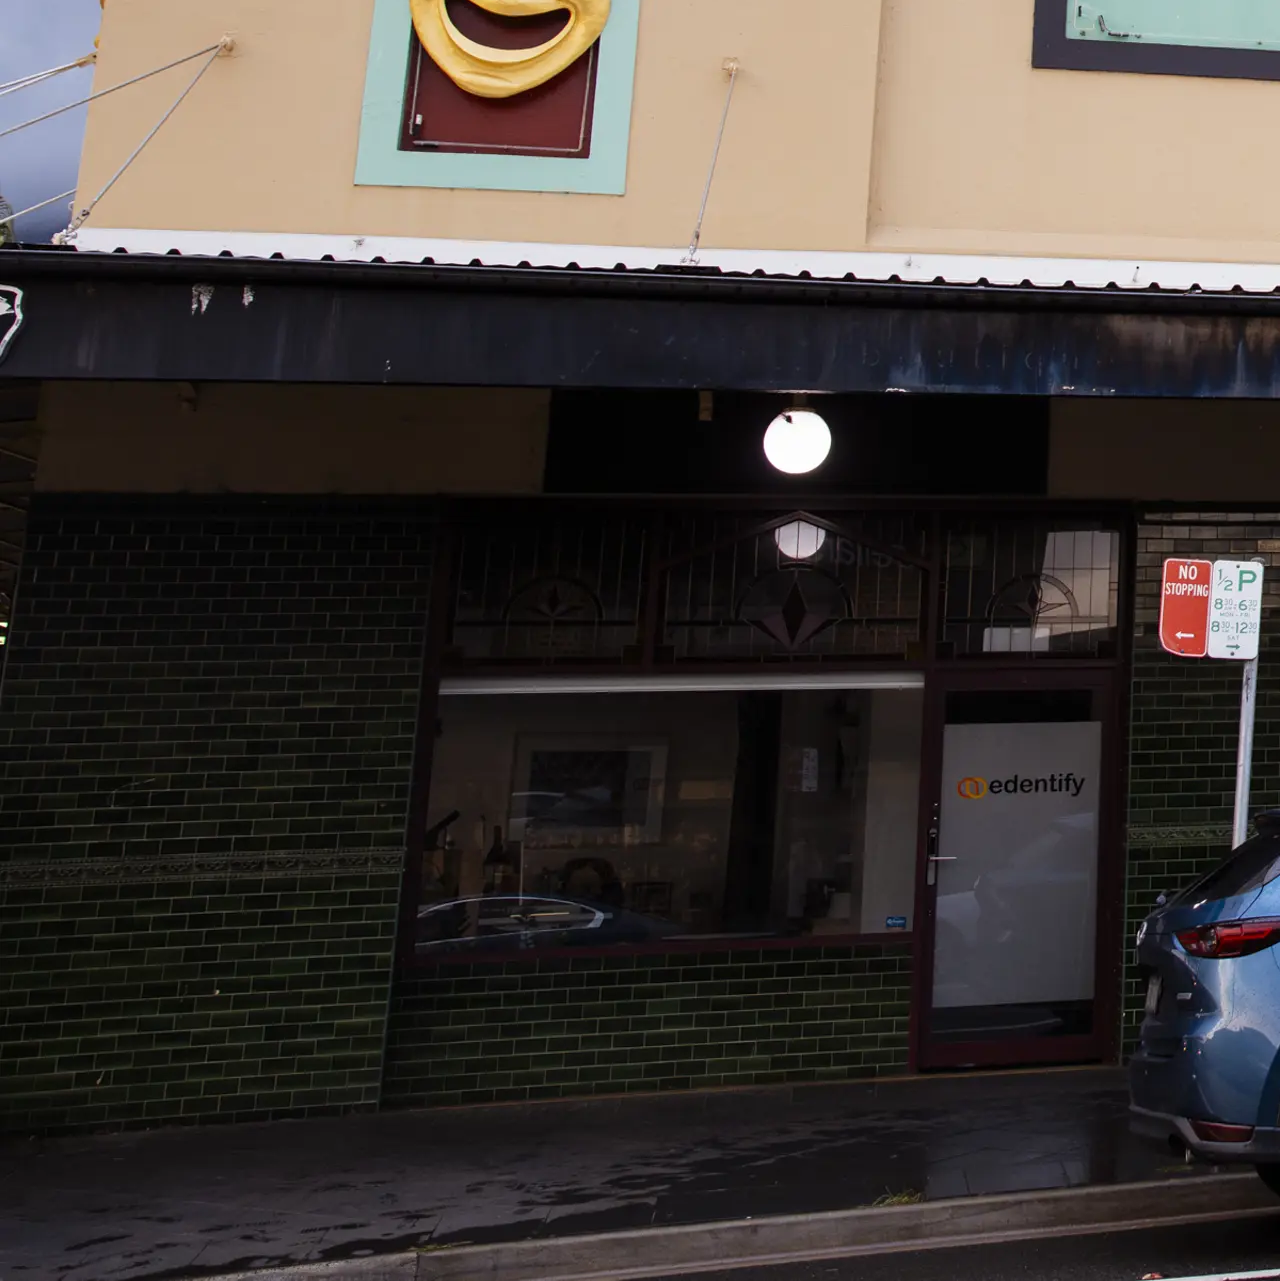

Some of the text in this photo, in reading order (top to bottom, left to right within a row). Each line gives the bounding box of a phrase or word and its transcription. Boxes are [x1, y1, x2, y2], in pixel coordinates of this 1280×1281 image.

[1178, 564, 1198, 581] NO
[1238, 570, 1257, 592] P
[1165, 582, 1209, 597] STOPPING
[989, 773, 1086, 797] edentify
